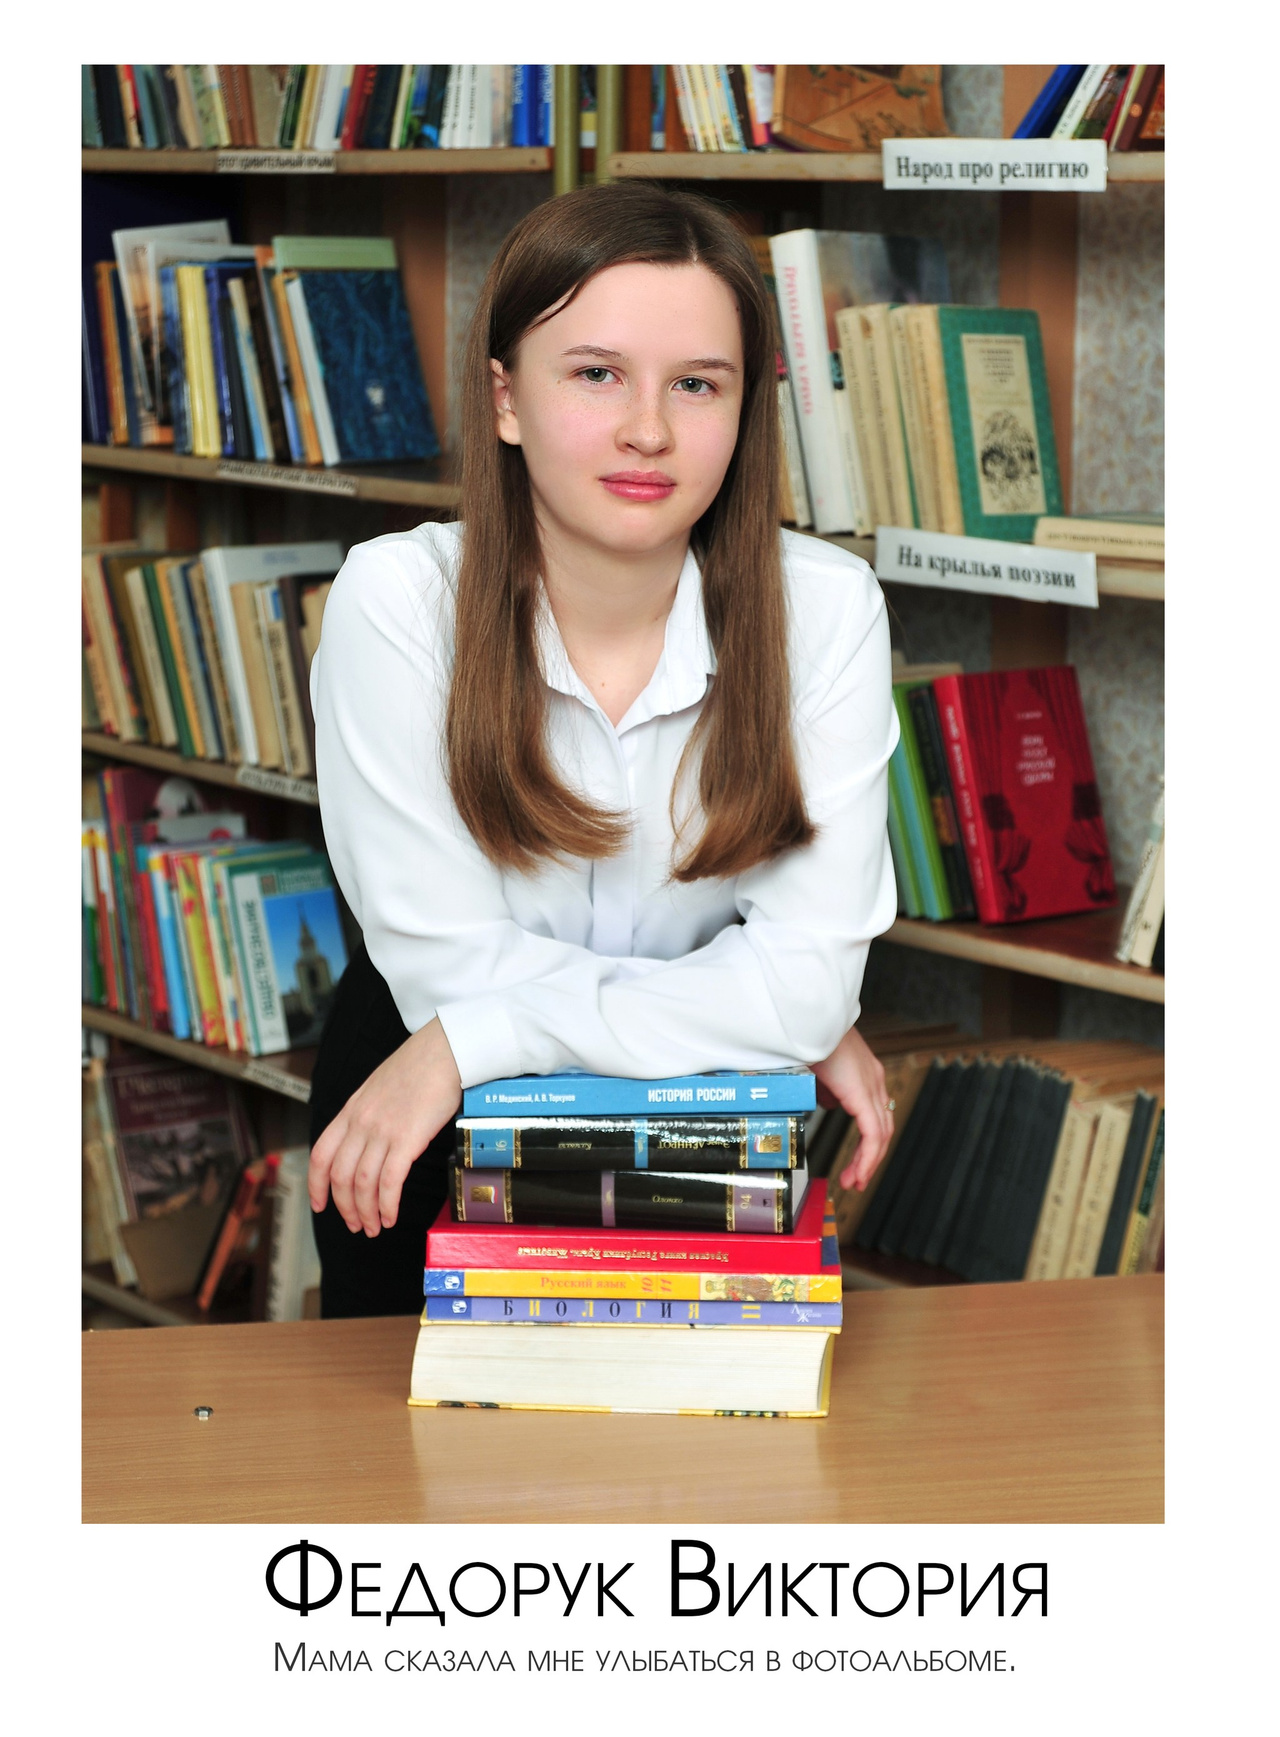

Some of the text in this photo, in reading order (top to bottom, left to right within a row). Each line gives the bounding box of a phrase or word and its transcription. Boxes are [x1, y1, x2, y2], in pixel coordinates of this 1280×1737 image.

[896, 155, 1089, 184] Народ про религию
[898, 544, 1076, 588] На крылья поэзии
[647, 1087, 768, 1103] ИСТОРИЯ РОССИИ 11
[652, 1194, 683, 1205] Олонхо
[516, 1247, 568, 1259] Животные
[602, 1249, 658, 1262] Республики
[659, 1252, 687, 1260] книга
[689, 1251, 730, 1263] Красная
[540, 1276, 627, 1291] Русский язык
[502, 1300, 701, 1320] БИОЛОГИЯ
